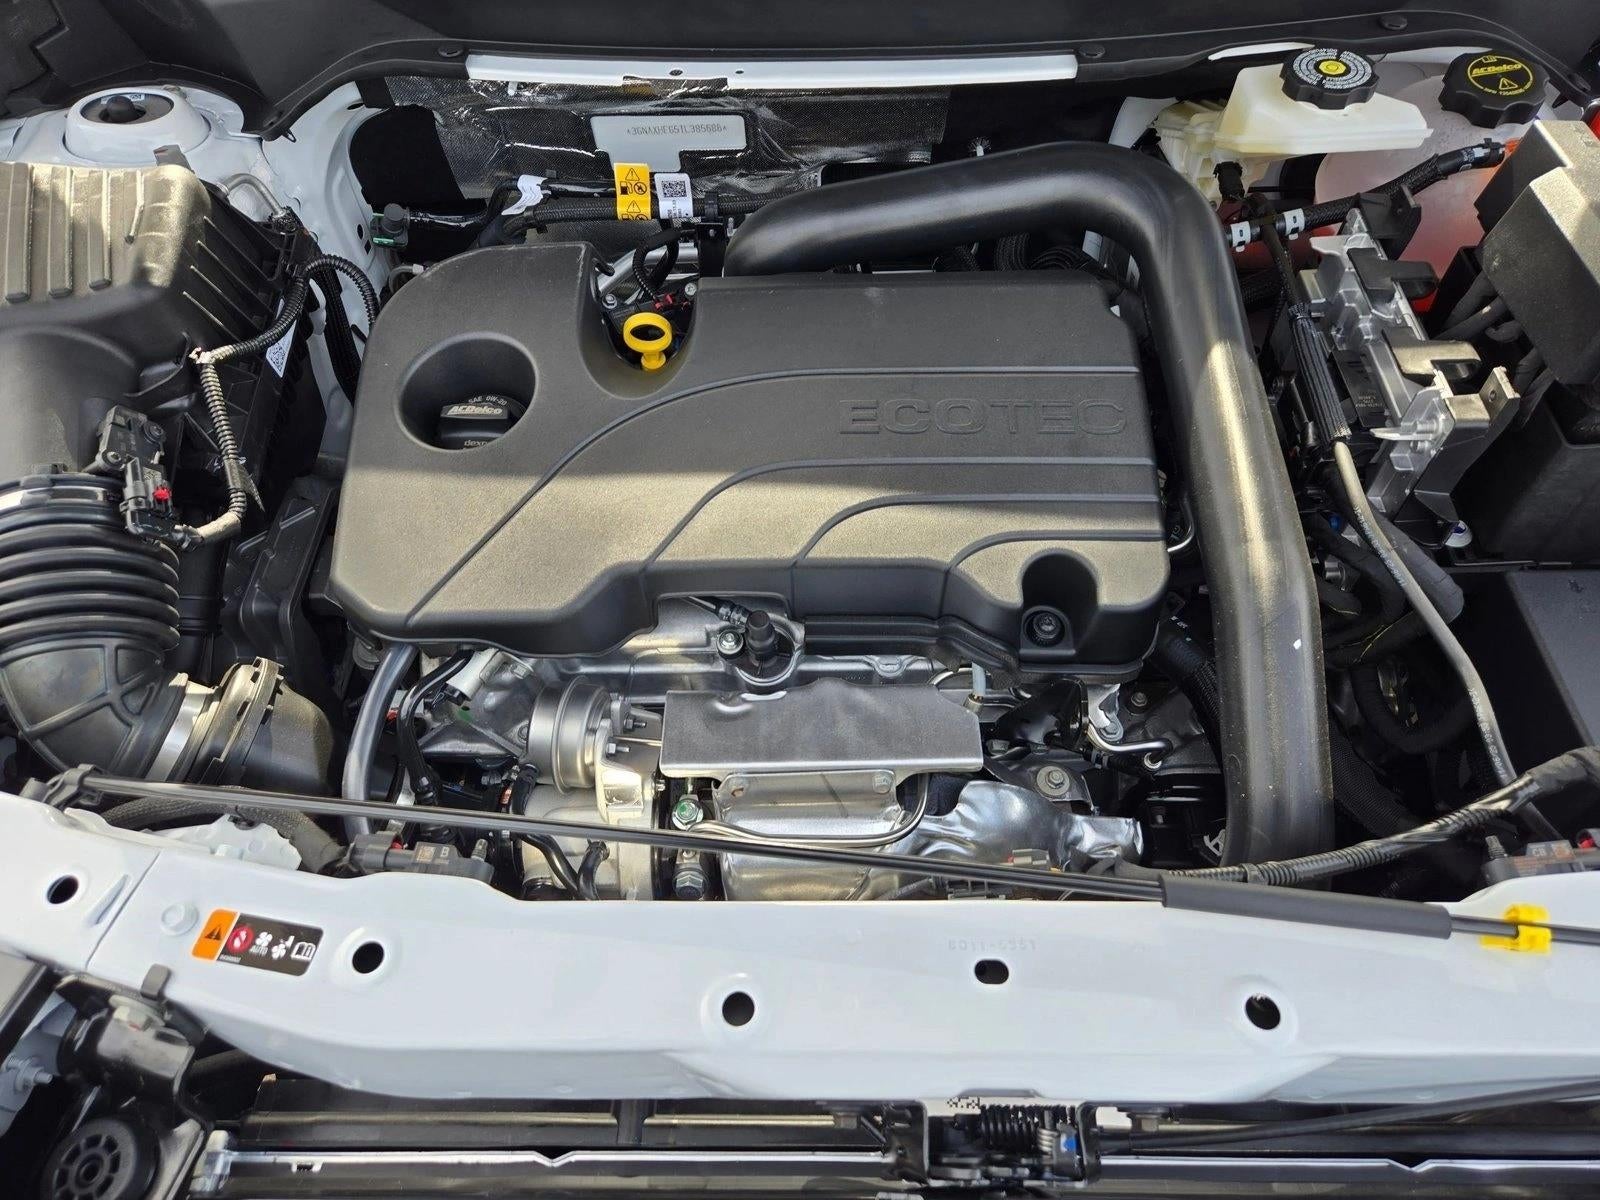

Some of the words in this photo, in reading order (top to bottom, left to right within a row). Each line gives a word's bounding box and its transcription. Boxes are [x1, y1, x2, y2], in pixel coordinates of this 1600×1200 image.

[1471, 64, 1522, 77] ACDelco
[446, 405, 503, 415] ACDelco
[839, 399, 1126, 435] ECOTEC
